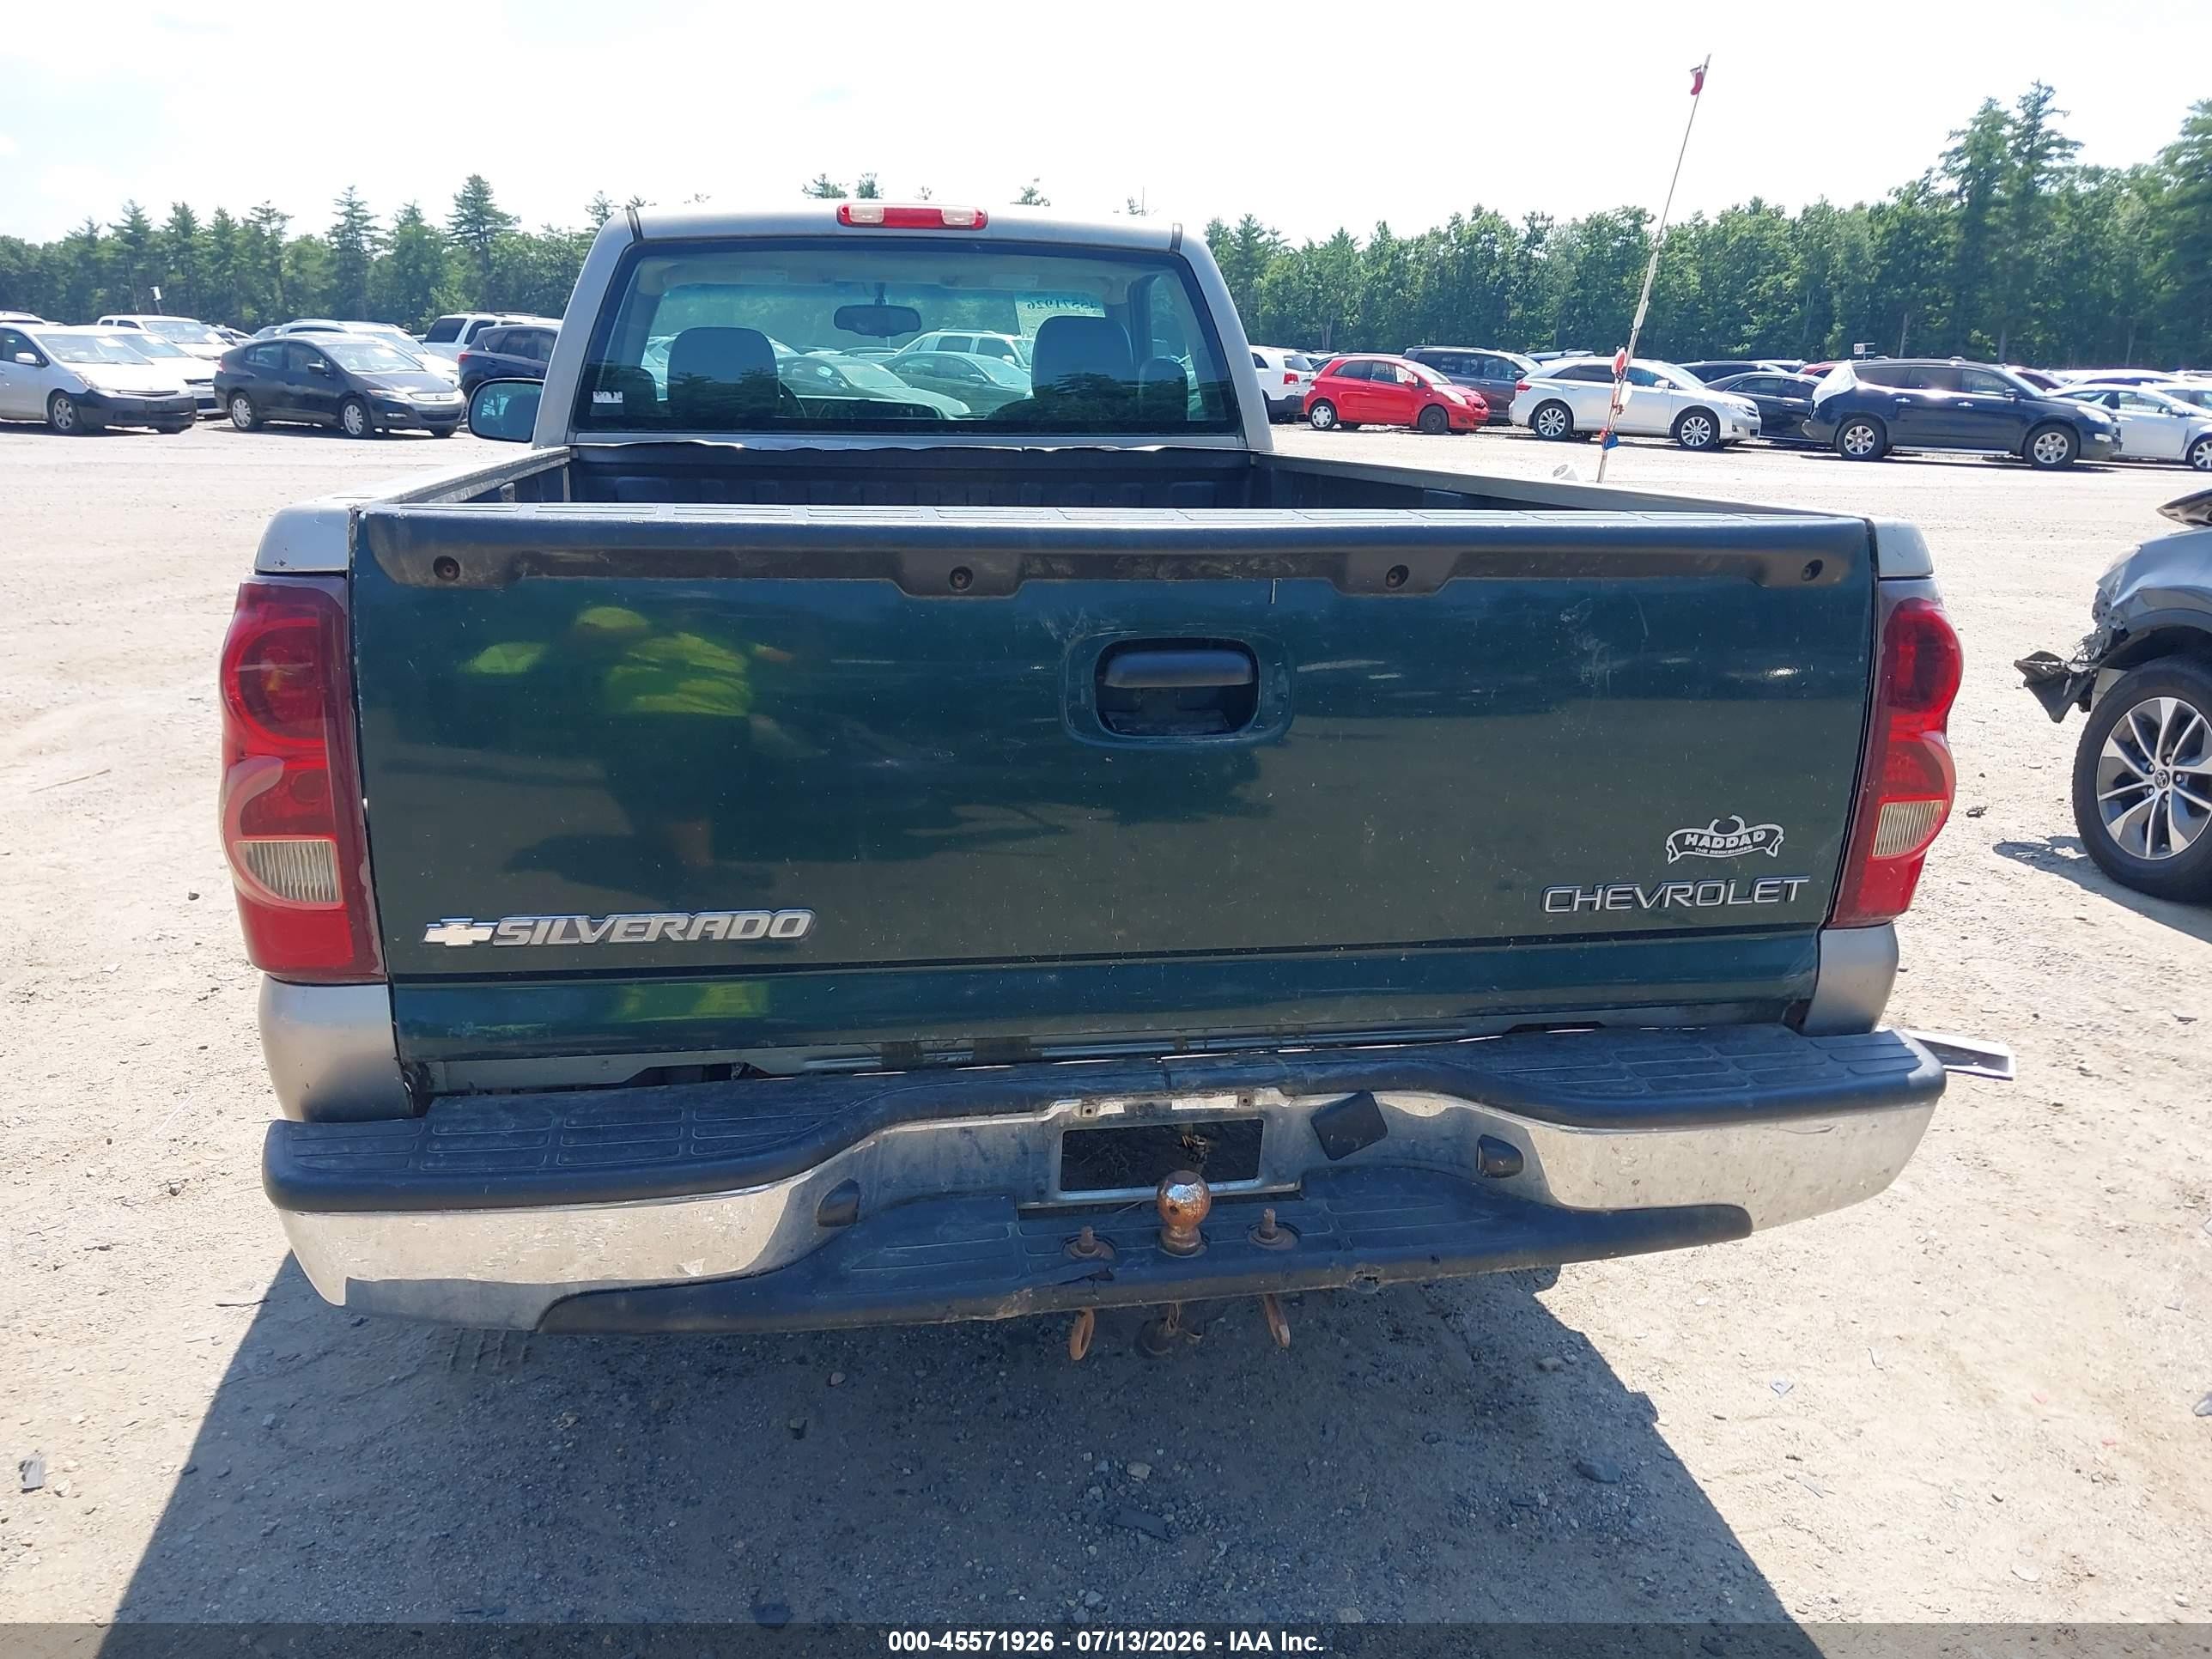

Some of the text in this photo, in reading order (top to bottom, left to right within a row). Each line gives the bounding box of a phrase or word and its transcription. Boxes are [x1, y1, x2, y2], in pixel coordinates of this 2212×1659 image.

[1684, 830, 1766, 849] HADDAD
[1543, 878, 1810, 913] CHEVROLET
[493, 909, 814, 946] SILVERADO
